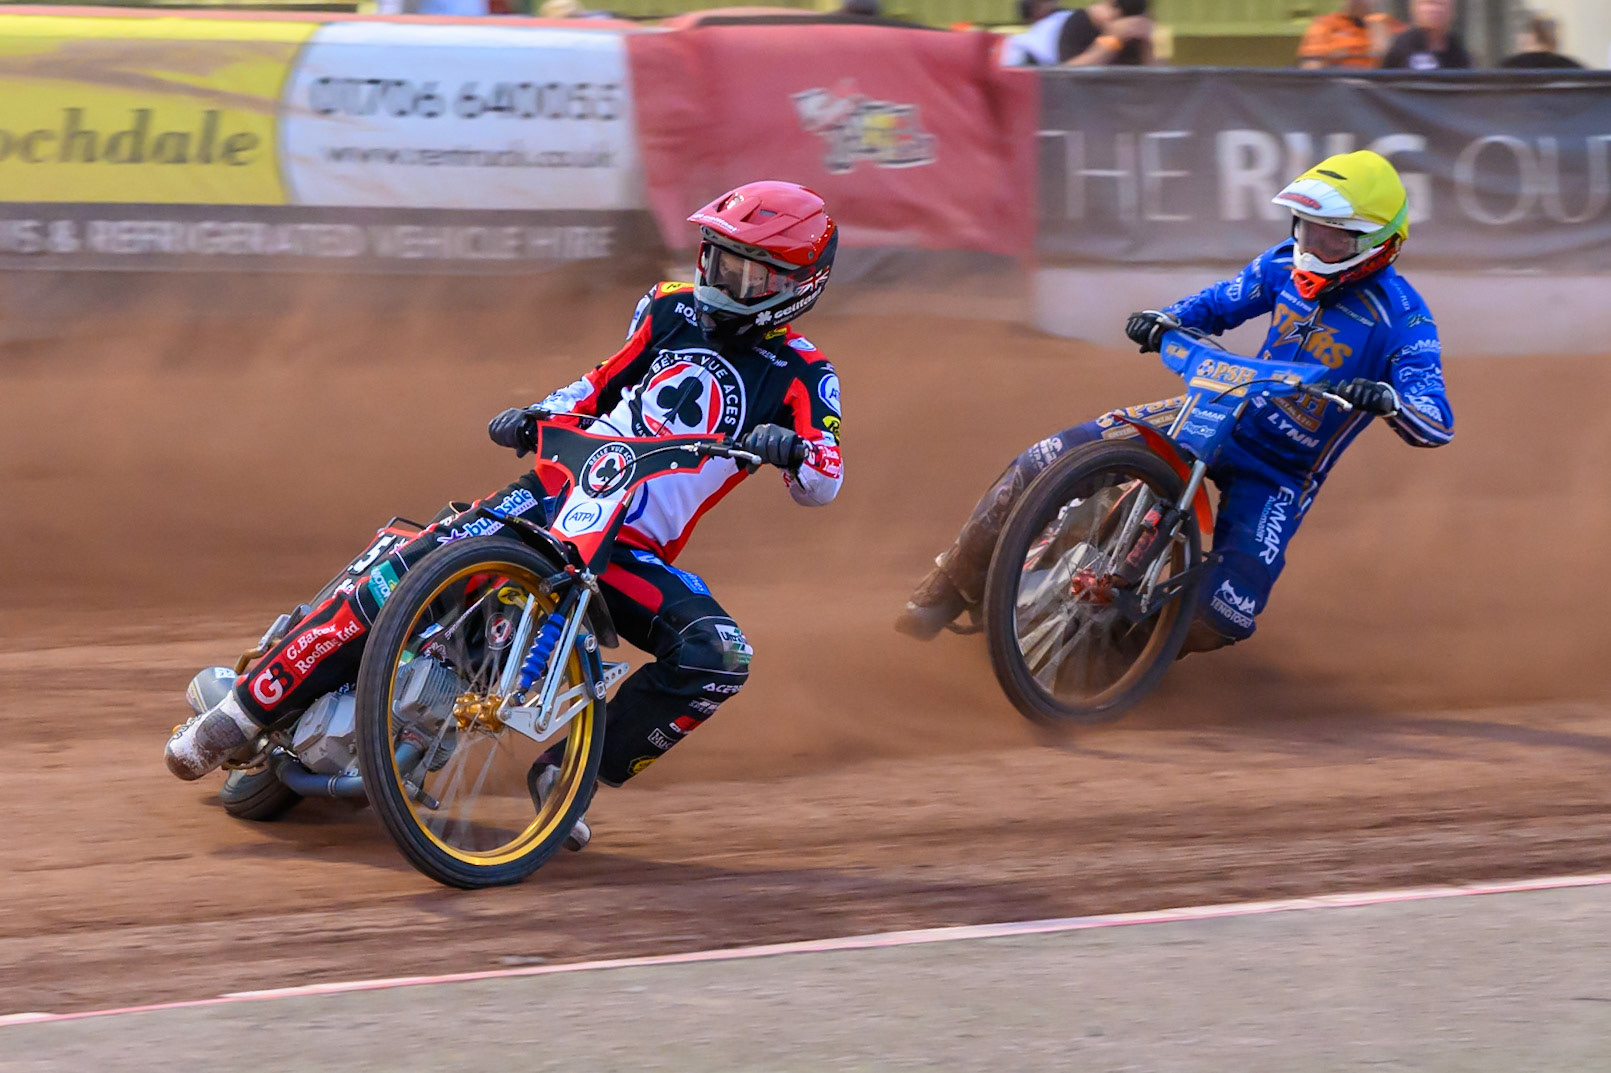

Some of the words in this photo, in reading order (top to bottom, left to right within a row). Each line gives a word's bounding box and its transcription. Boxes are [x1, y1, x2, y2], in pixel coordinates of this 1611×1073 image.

[1454, 134, 1611, 225] OU
[1213, 361, 1259, 384] PSH
[701, 356, 728, 379] VUE
[723, 384, 739, 426] ACES
[1267, 412, 1320, 448] LYNN
[611, 445, 625, 455] VUE
[569, 511, 595, 522] ATPI
[1259, 486, 1295, 565] EVMAR
[353, 536, 396, 571] 5
[336, 620, 360, 643] Ltd
[253, 661, 295, 705] GB
